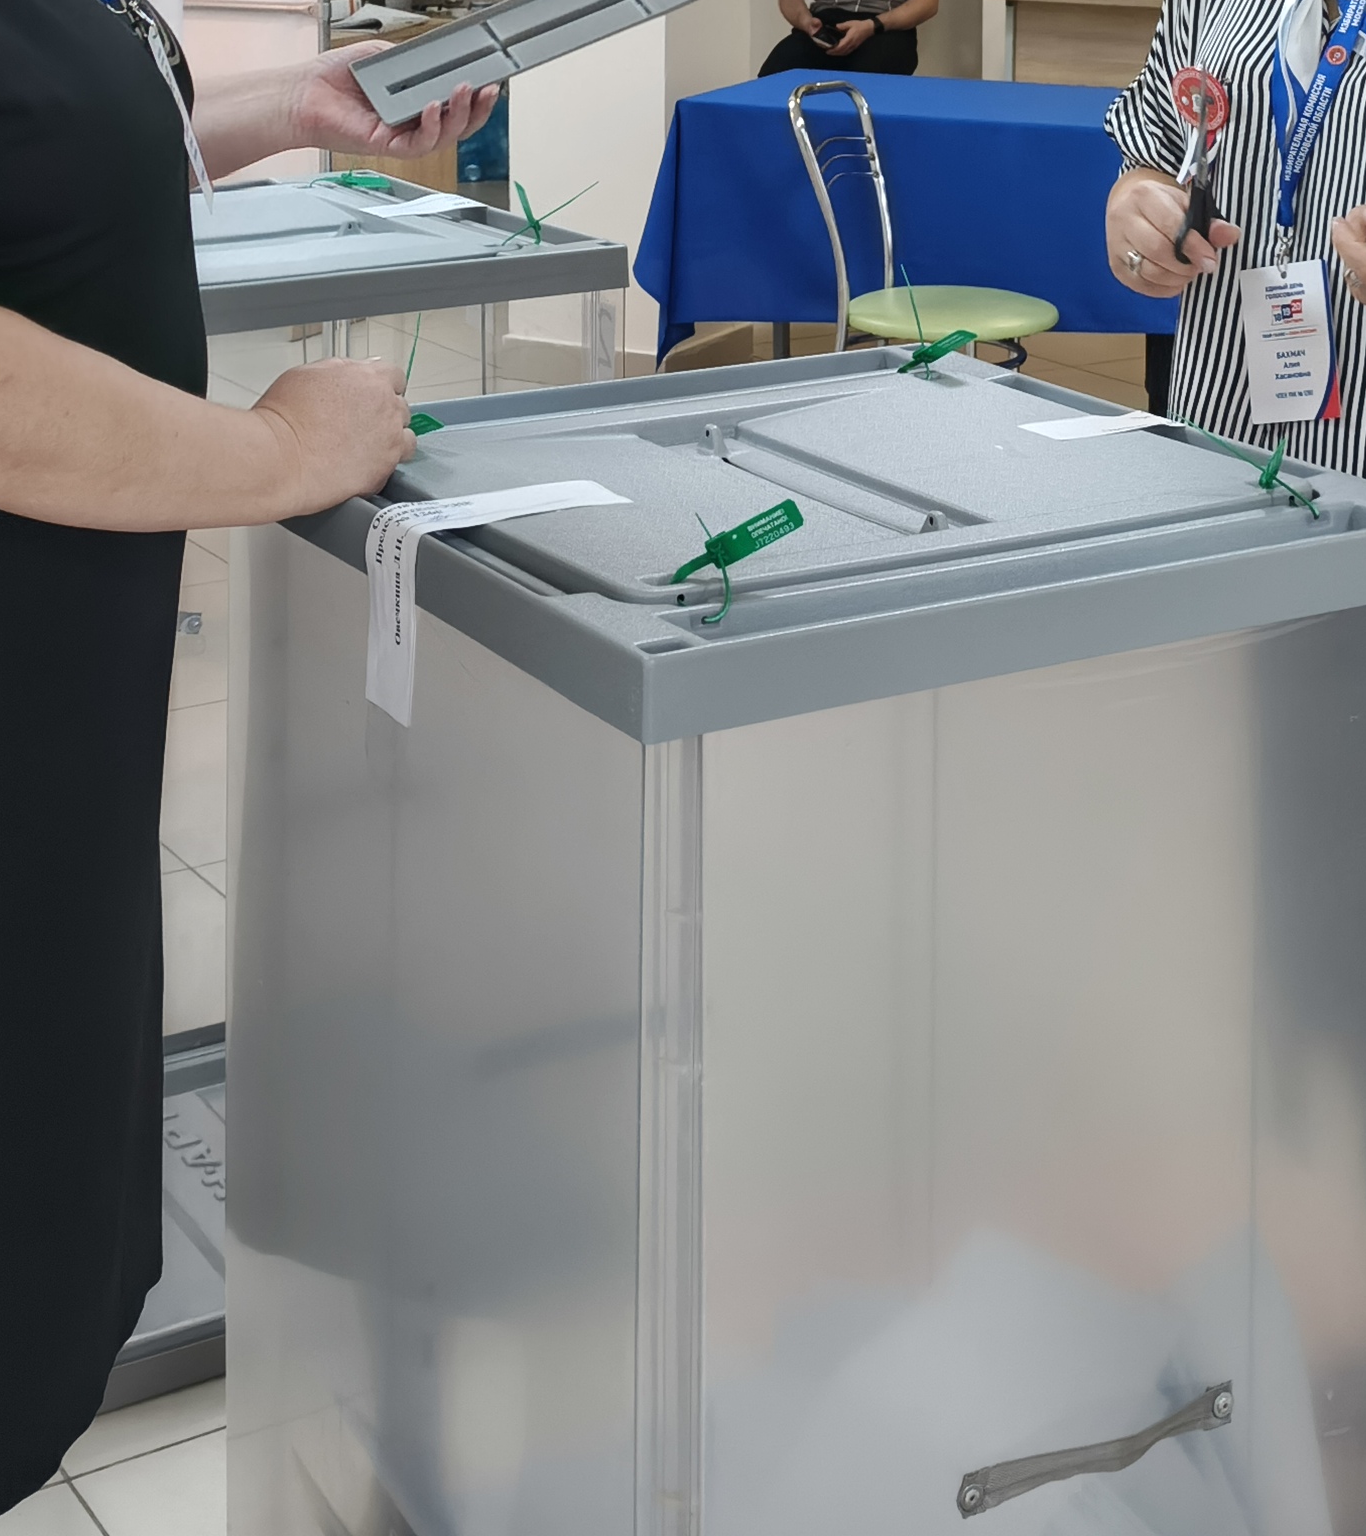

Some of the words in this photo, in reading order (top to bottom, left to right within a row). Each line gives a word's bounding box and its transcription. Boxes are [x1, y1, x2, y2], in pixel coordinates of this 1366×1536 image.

[1284, 115, 1311, 182] ИЗБИРАТЕЛЬНАЯ
[1302, 73, 1327, 117] КОМИССИЯ
[1293, 120, 1319, 174] МОСКОВСКОЙ
[1312, 87, 1333, 123] ОБЛАСТИ
[1265, 289, 1305, 300] ГОЛОСОВАНИЯ
[1276, 350, 1306, 359] БАХМАЧ
[1283, 361, 1300, 369] Алия
[1275, 371, 1311, 380] Хасановна
[747, 508, 785, 532] ВНИМАНИЕ!
[750, 514, 789, 539] ОПЕЧАТАНО!
